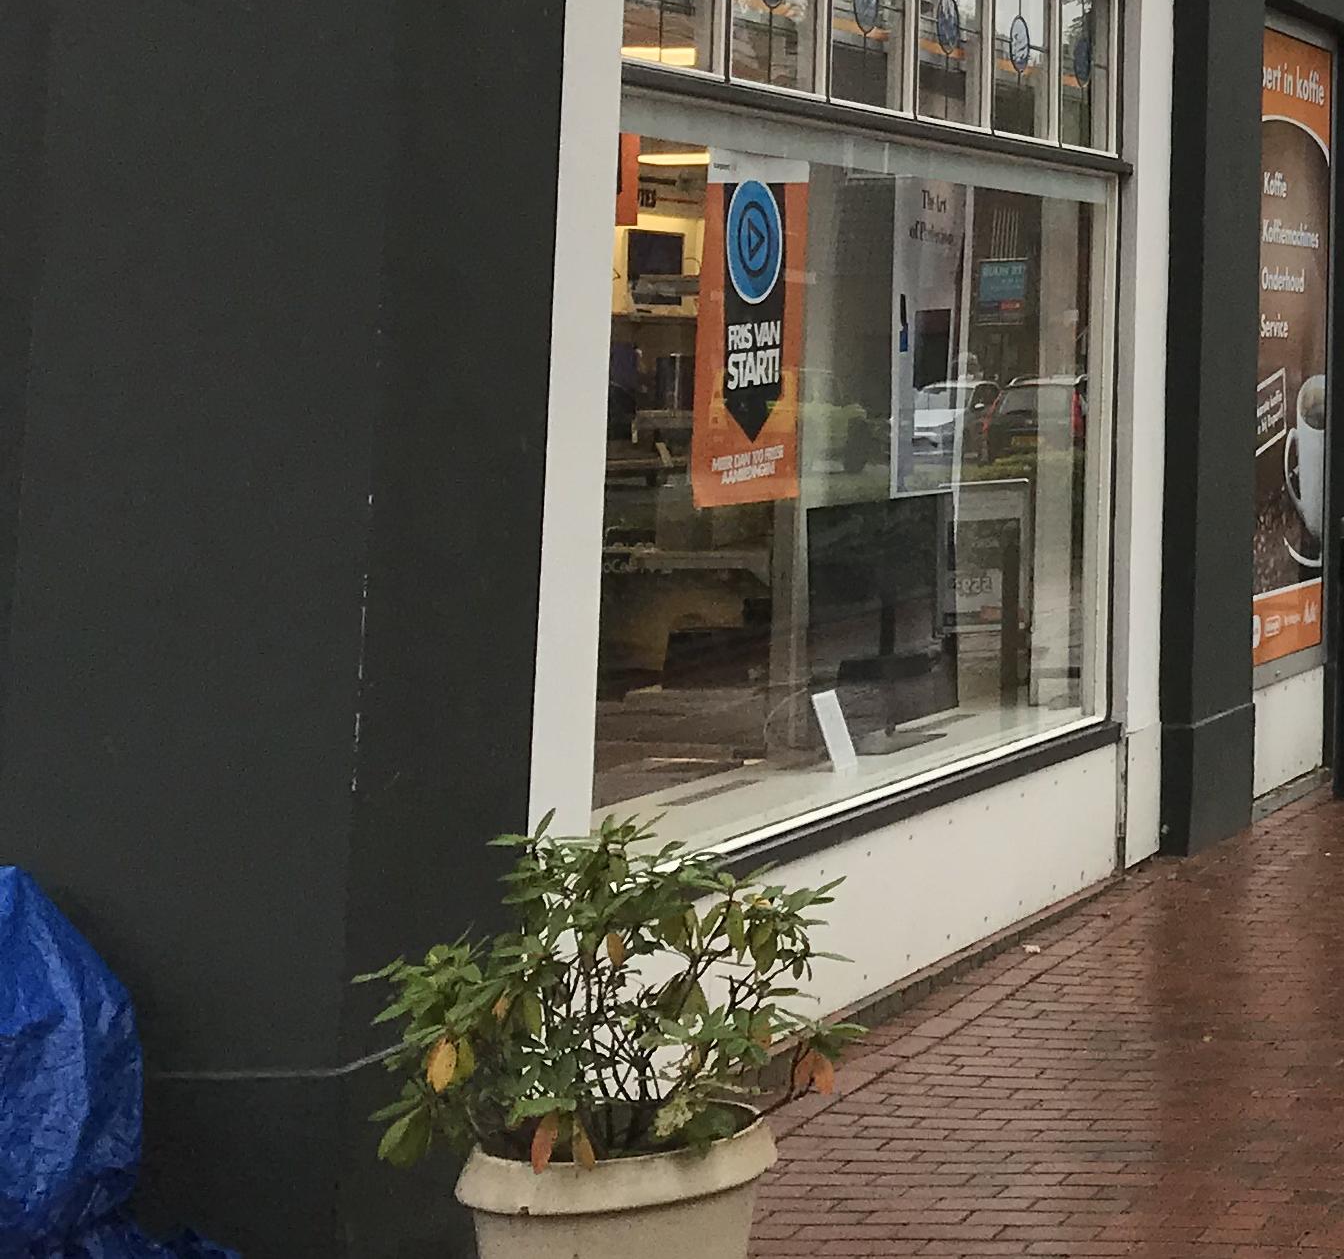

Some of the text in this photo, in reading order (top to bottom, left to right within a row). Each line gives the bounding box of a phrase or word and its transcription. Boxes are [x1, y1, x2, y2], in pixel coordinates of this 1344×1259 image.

[1284, 63, 1293, 96] in
[1296, 65, 1325, 106] koffie
[1263, 171, 1287, 198] Koffie
[1262, 218, 1319, 249] Koffiemachines
[1261, 266, 1305, 293] Onderhoud
[728, 320, 781, 350] FRIS VAN
[1260, 312, 1289, 339] Service
[727, 348, 780, 390] START!
